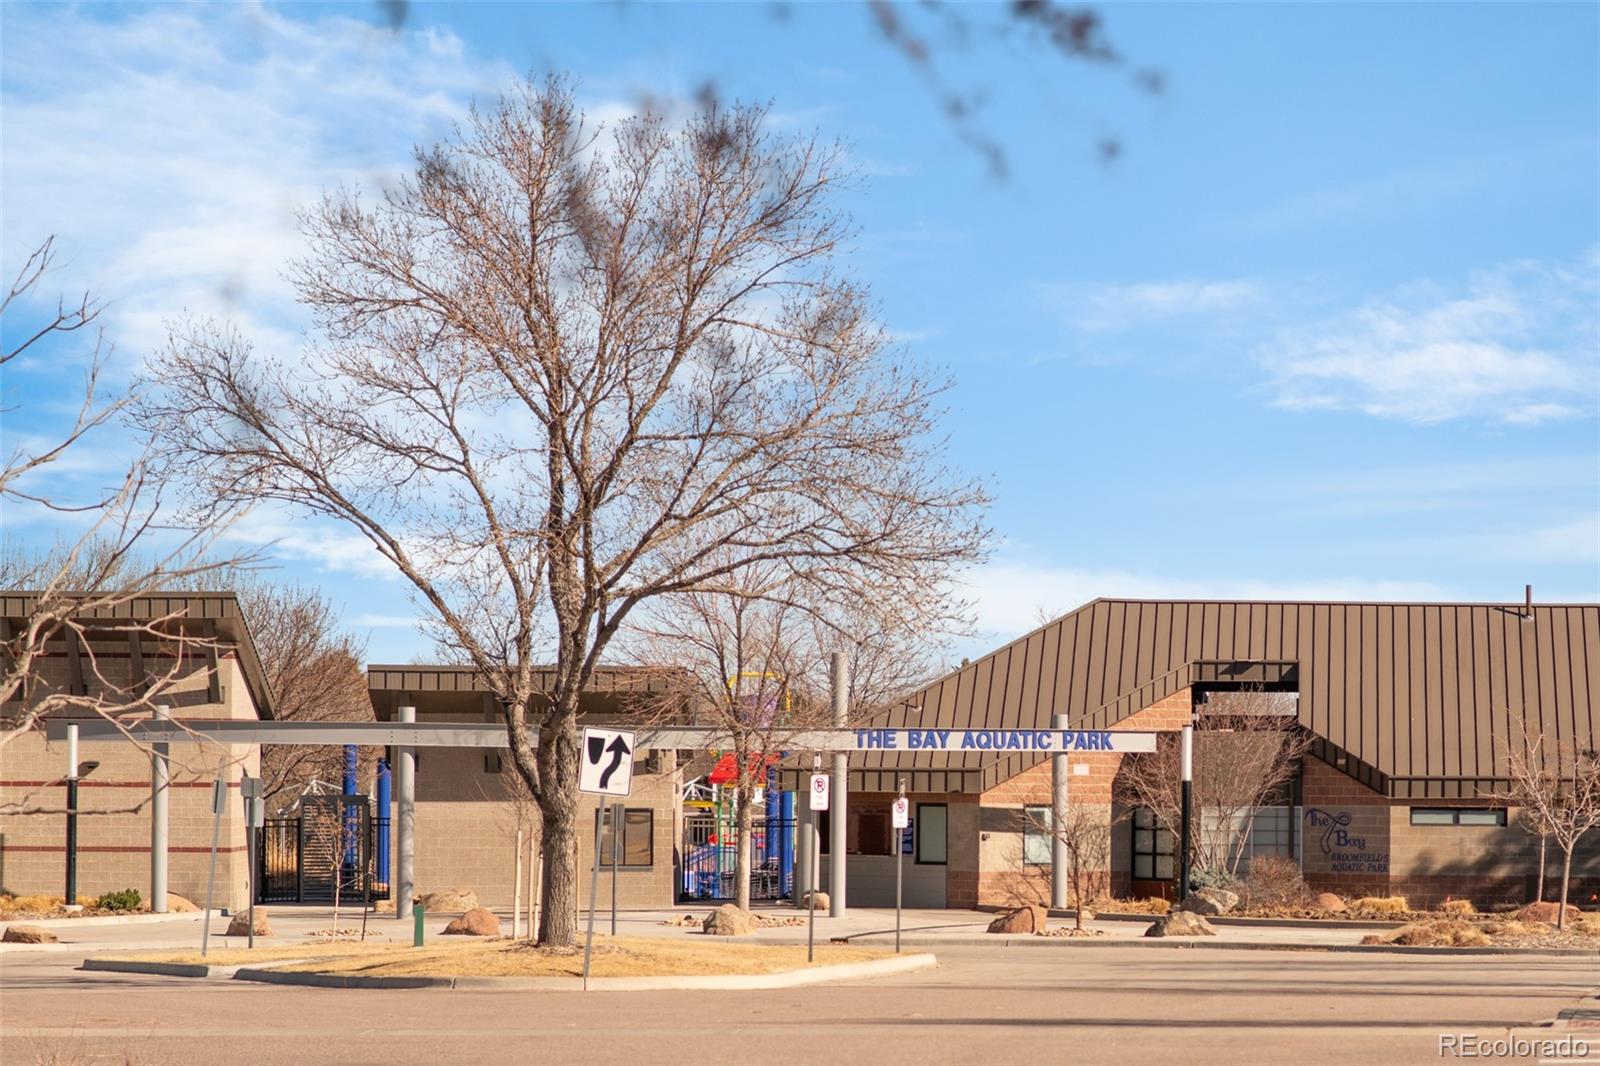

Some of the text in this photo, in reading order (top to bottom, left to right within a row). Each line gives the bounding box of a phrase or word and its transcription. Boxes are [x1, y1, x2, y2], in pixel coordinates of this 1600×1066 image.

[855, 729, 1113, 750] THE BAY AQUATIC PARK
[1305, 808, 1329, 827] The
[1334, 829, 1366, 850] Bay
[1331, 863, 1389, 873] AQUATIC PARK
